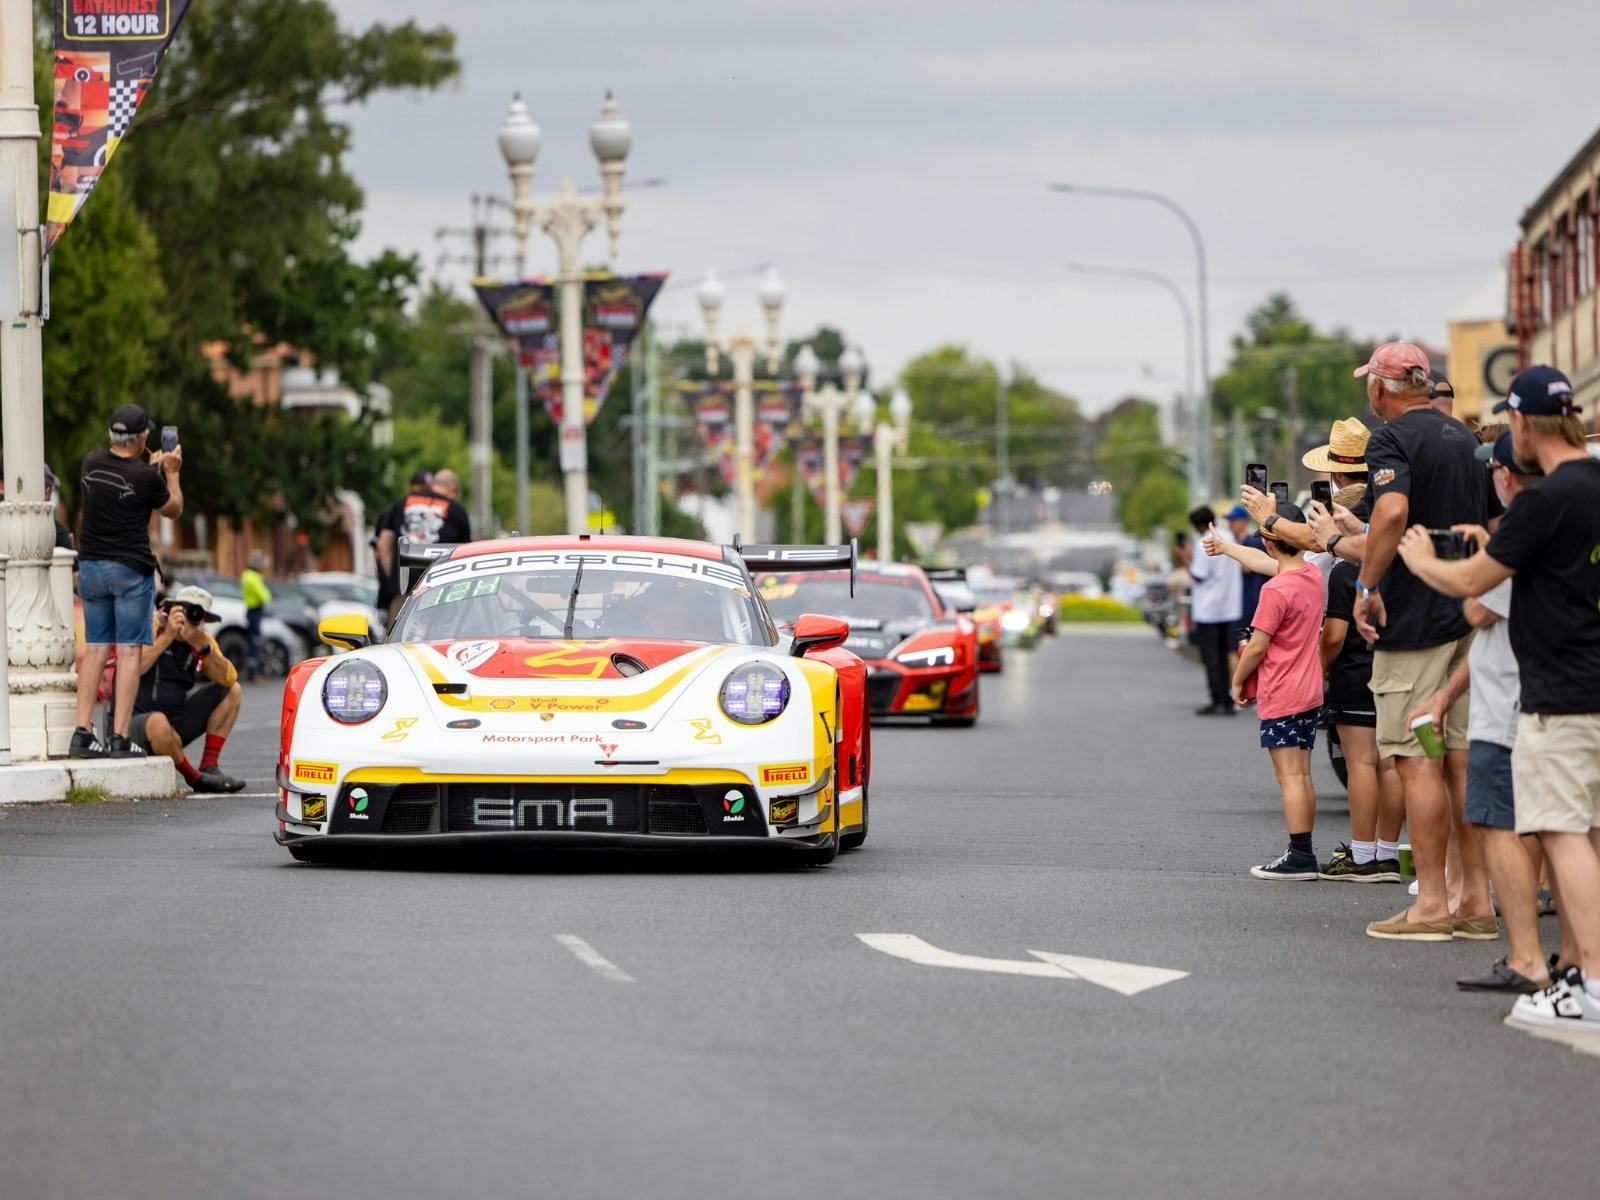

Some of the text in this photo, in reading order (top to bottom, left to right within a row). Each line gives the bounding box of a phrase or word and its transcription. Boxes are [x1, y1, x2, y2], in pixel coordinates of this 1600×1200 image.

[72, 0, 159, 14] BATHURST
[74, 14, 159, 34] 12 HOUR
[425, 553, 745, 587] PORSCHE
[482, 734, 604, 745] Motorsport Park
[295, 764, 334, 780] PIRELLI
[763, 766, 807, 782] PIRELLI
[473, 798, 614, 826] EMA
